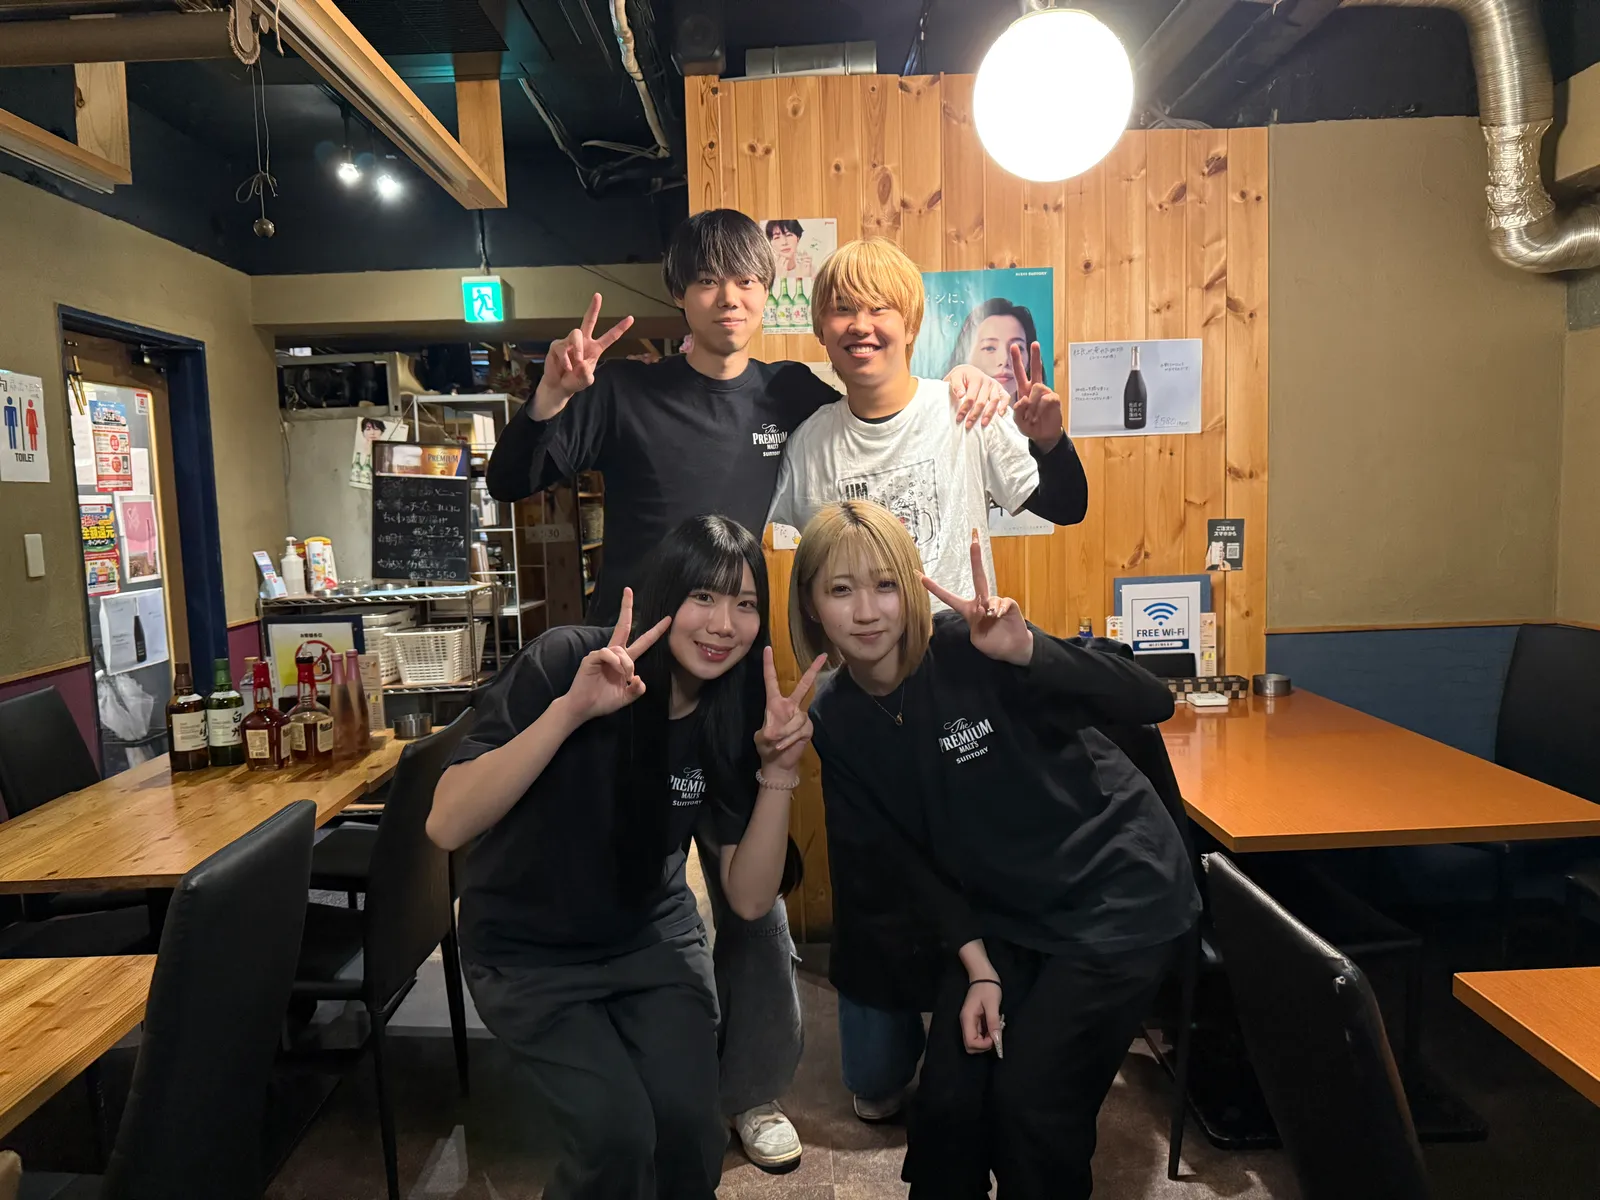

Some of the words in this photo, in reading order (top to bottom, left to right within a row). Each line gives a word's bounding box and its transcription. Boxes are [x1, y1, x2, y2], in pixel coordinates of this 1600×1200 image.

[762, 423, 779, 433] The
[752, 431, 788, 445] PREMIUM
[15, 452, 35, 463] TOILET
[427, 453, 459, 463] PREMIUM
[1136, 629, 1160, 638] FREE
[1162, 627, 1185, 637] Wi-Fi
[943, 717, 974, 734] The
[938, 718, 994, 754] PREMIUM
[958, 740, 980, 754] MALT'S
[955, 746, 989, 764] SUNTORY
[683, 766, 705, 780] The
[672, 799, 704, 807] SUNTORY
